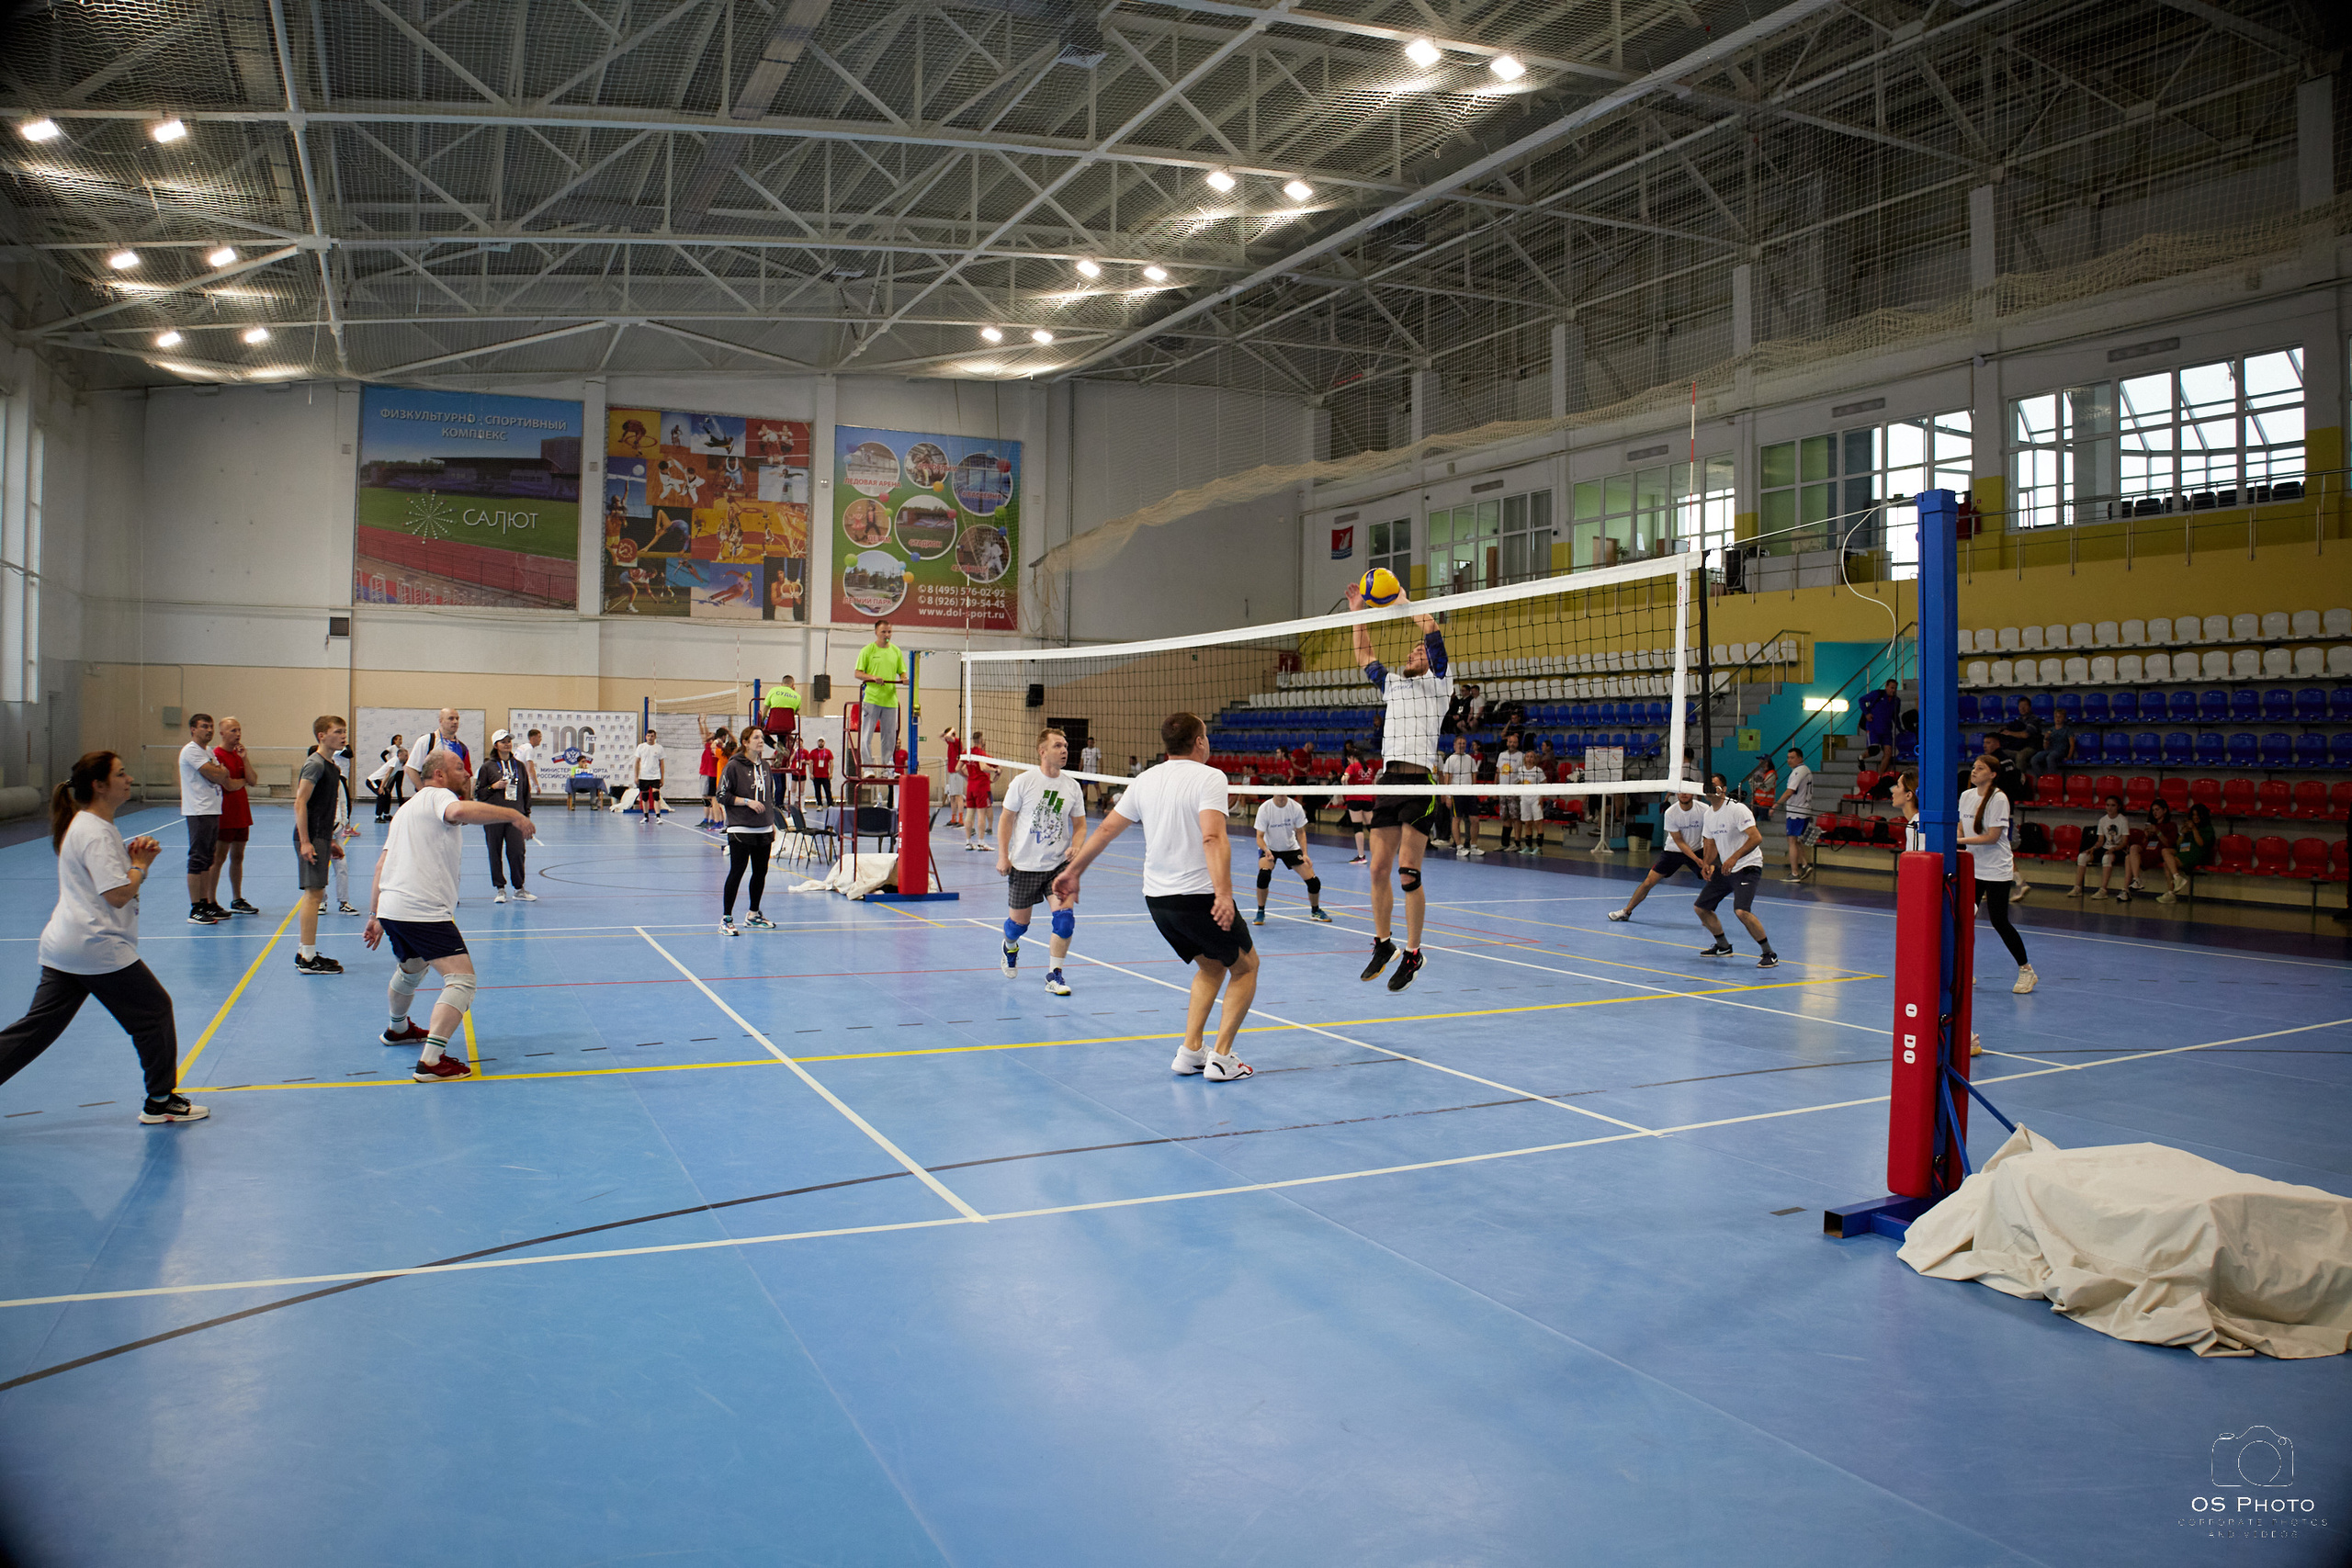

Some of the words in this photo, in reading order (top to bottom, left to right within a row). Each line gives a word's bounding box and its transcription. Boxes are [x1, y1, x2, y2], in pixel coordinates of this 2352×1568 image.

[379, 409, 476, 423] ФИЗКУЛЬТУРНО
[485, 415, 567, 431] СПОРТИВНЫЙ
[442, 427, 508, 441] КОМПЛЕКС
[844, 478, 877, 487] ЛЕДОВАЯ
[463, 509, 538, 535] САЛЮТ
[927, 585, 933, 593] 8
[935, 585, 958, 595] (495)
[927, 596, 933, 604] 8
[935, 596, 958, 606] (926)
[775, 691, 797, 699] СУДЬЯ
[550, 726, 595, 755] 100
